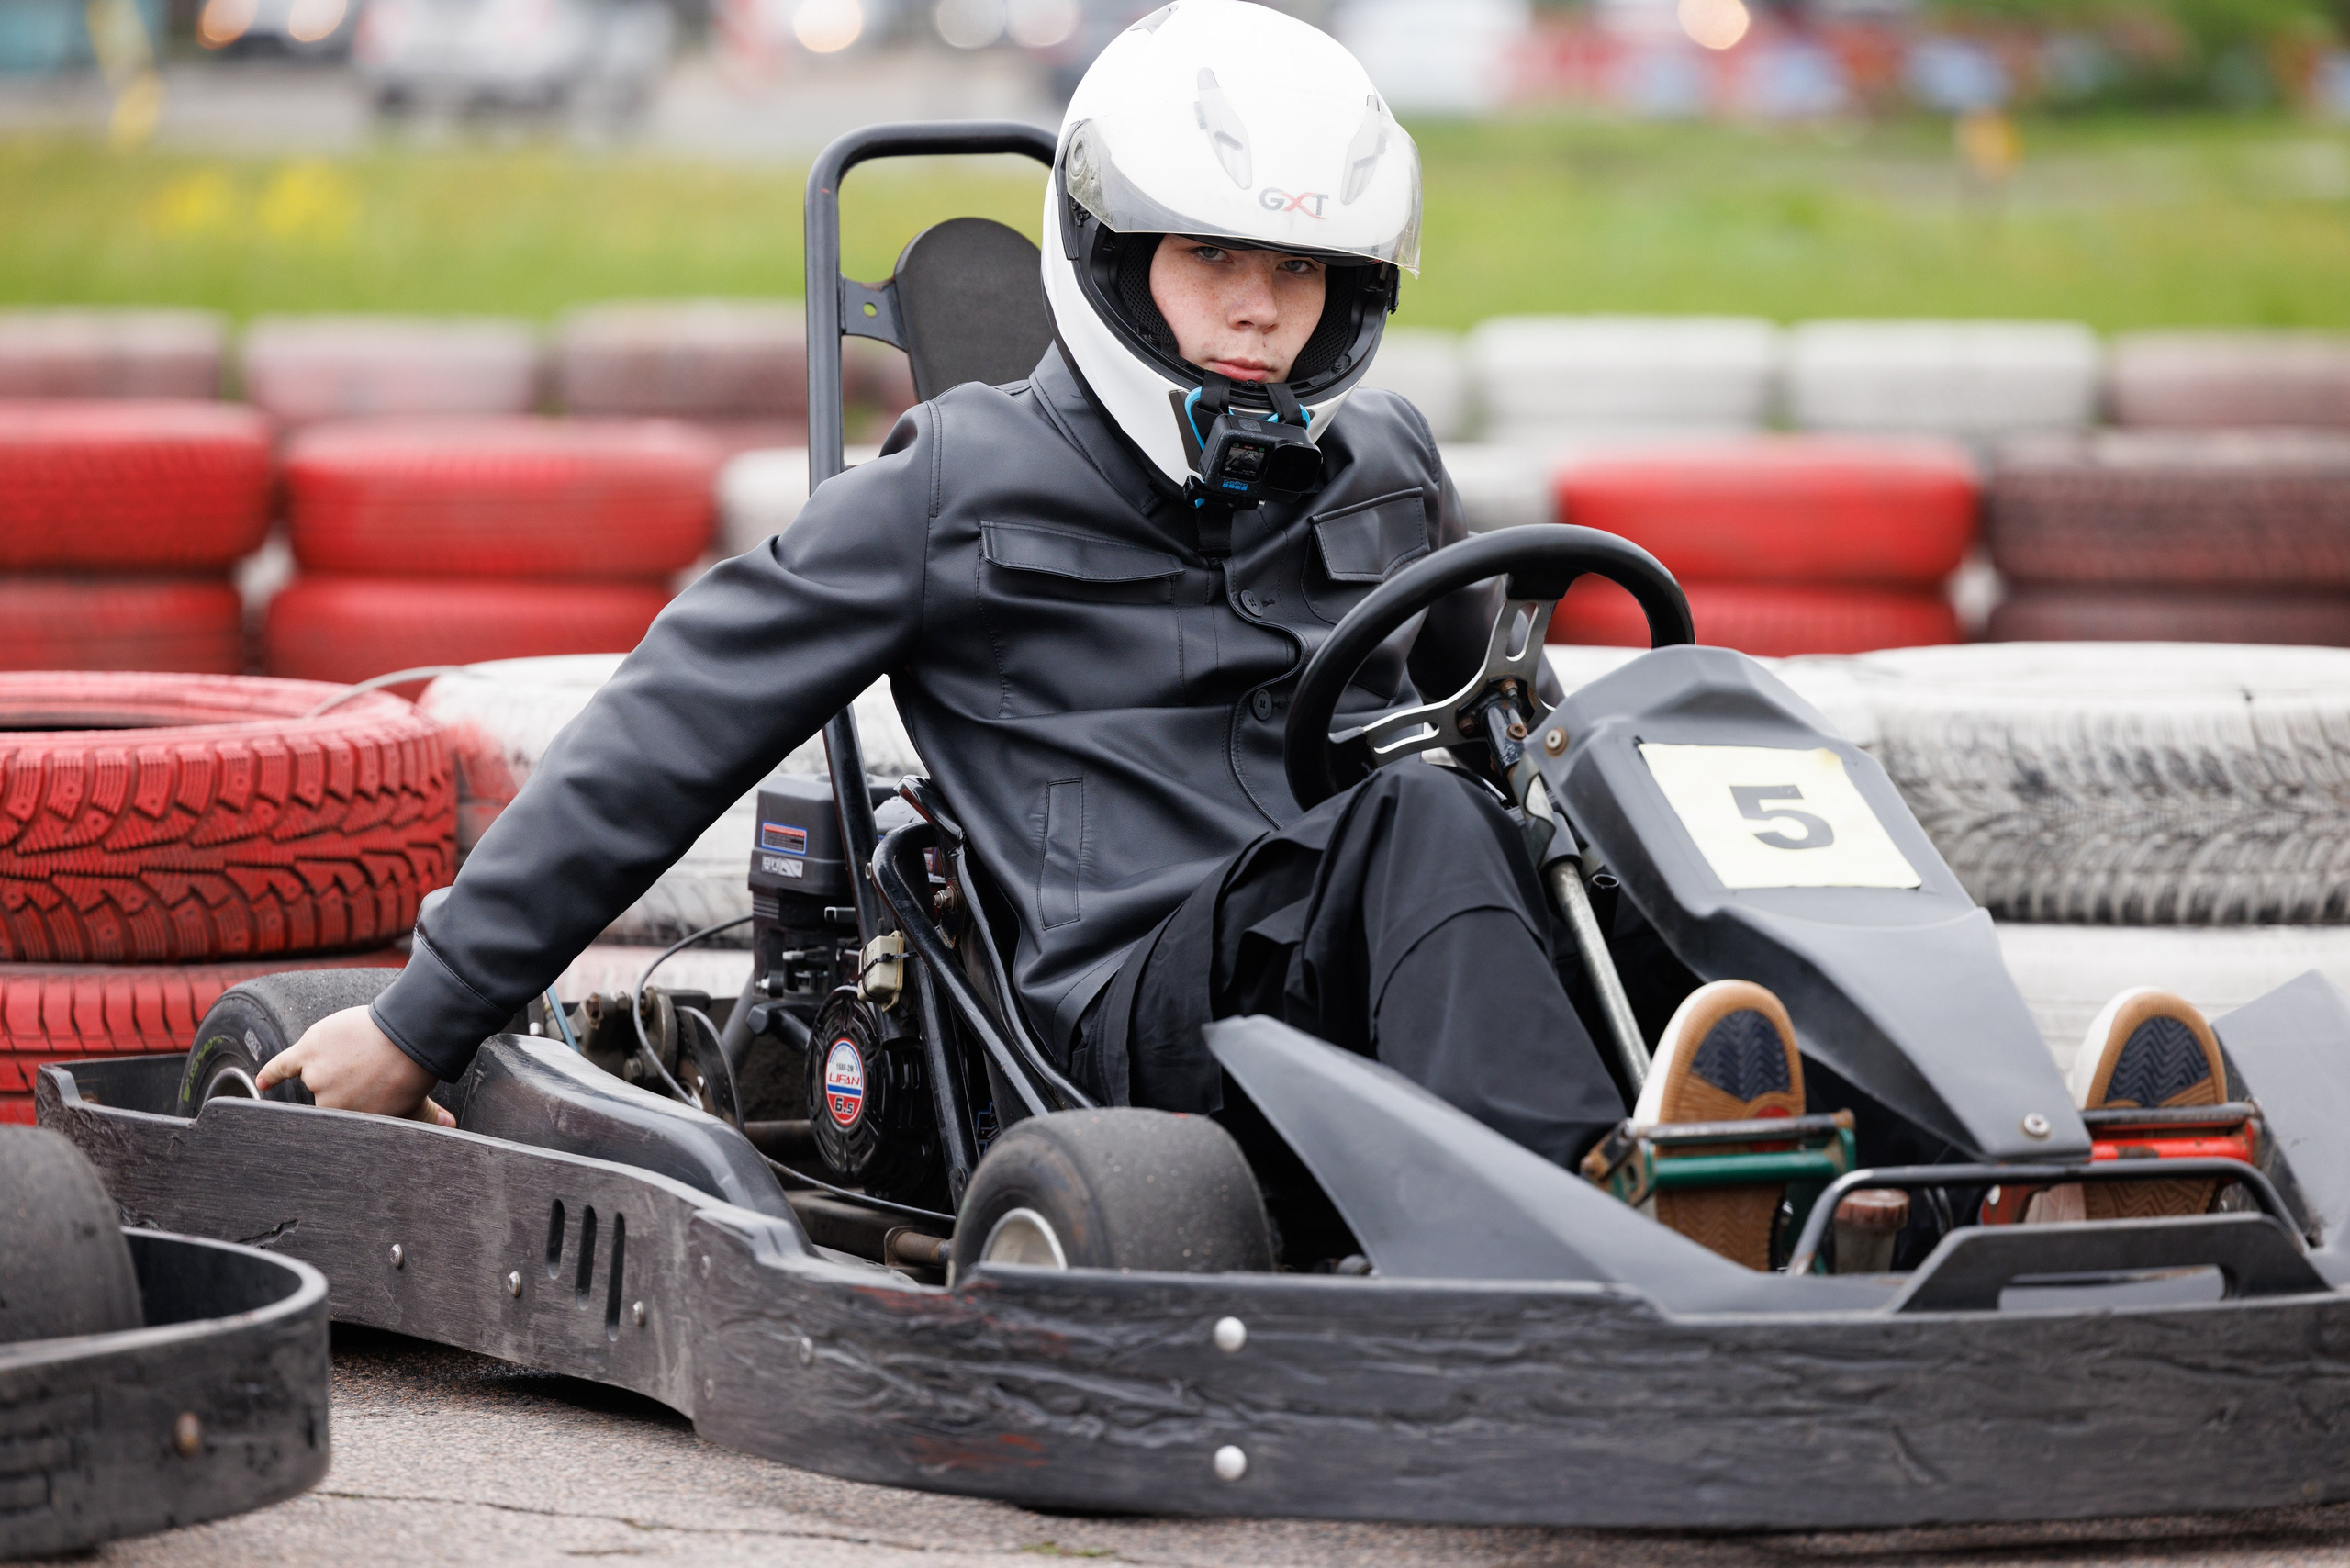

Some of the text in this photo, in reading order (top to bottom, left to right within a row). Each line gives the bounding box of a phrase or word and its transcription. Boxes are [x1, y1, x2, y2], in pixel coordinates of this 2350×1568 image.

[1259, 186, 1329, 219] GXT
[1224, 479, 1248, 487] GoPro
[1729, 784, 1835, 850] 5
[829, 1072, 861, 1086] LIFAN
[834, 1096, 854, 1114] 6.5
